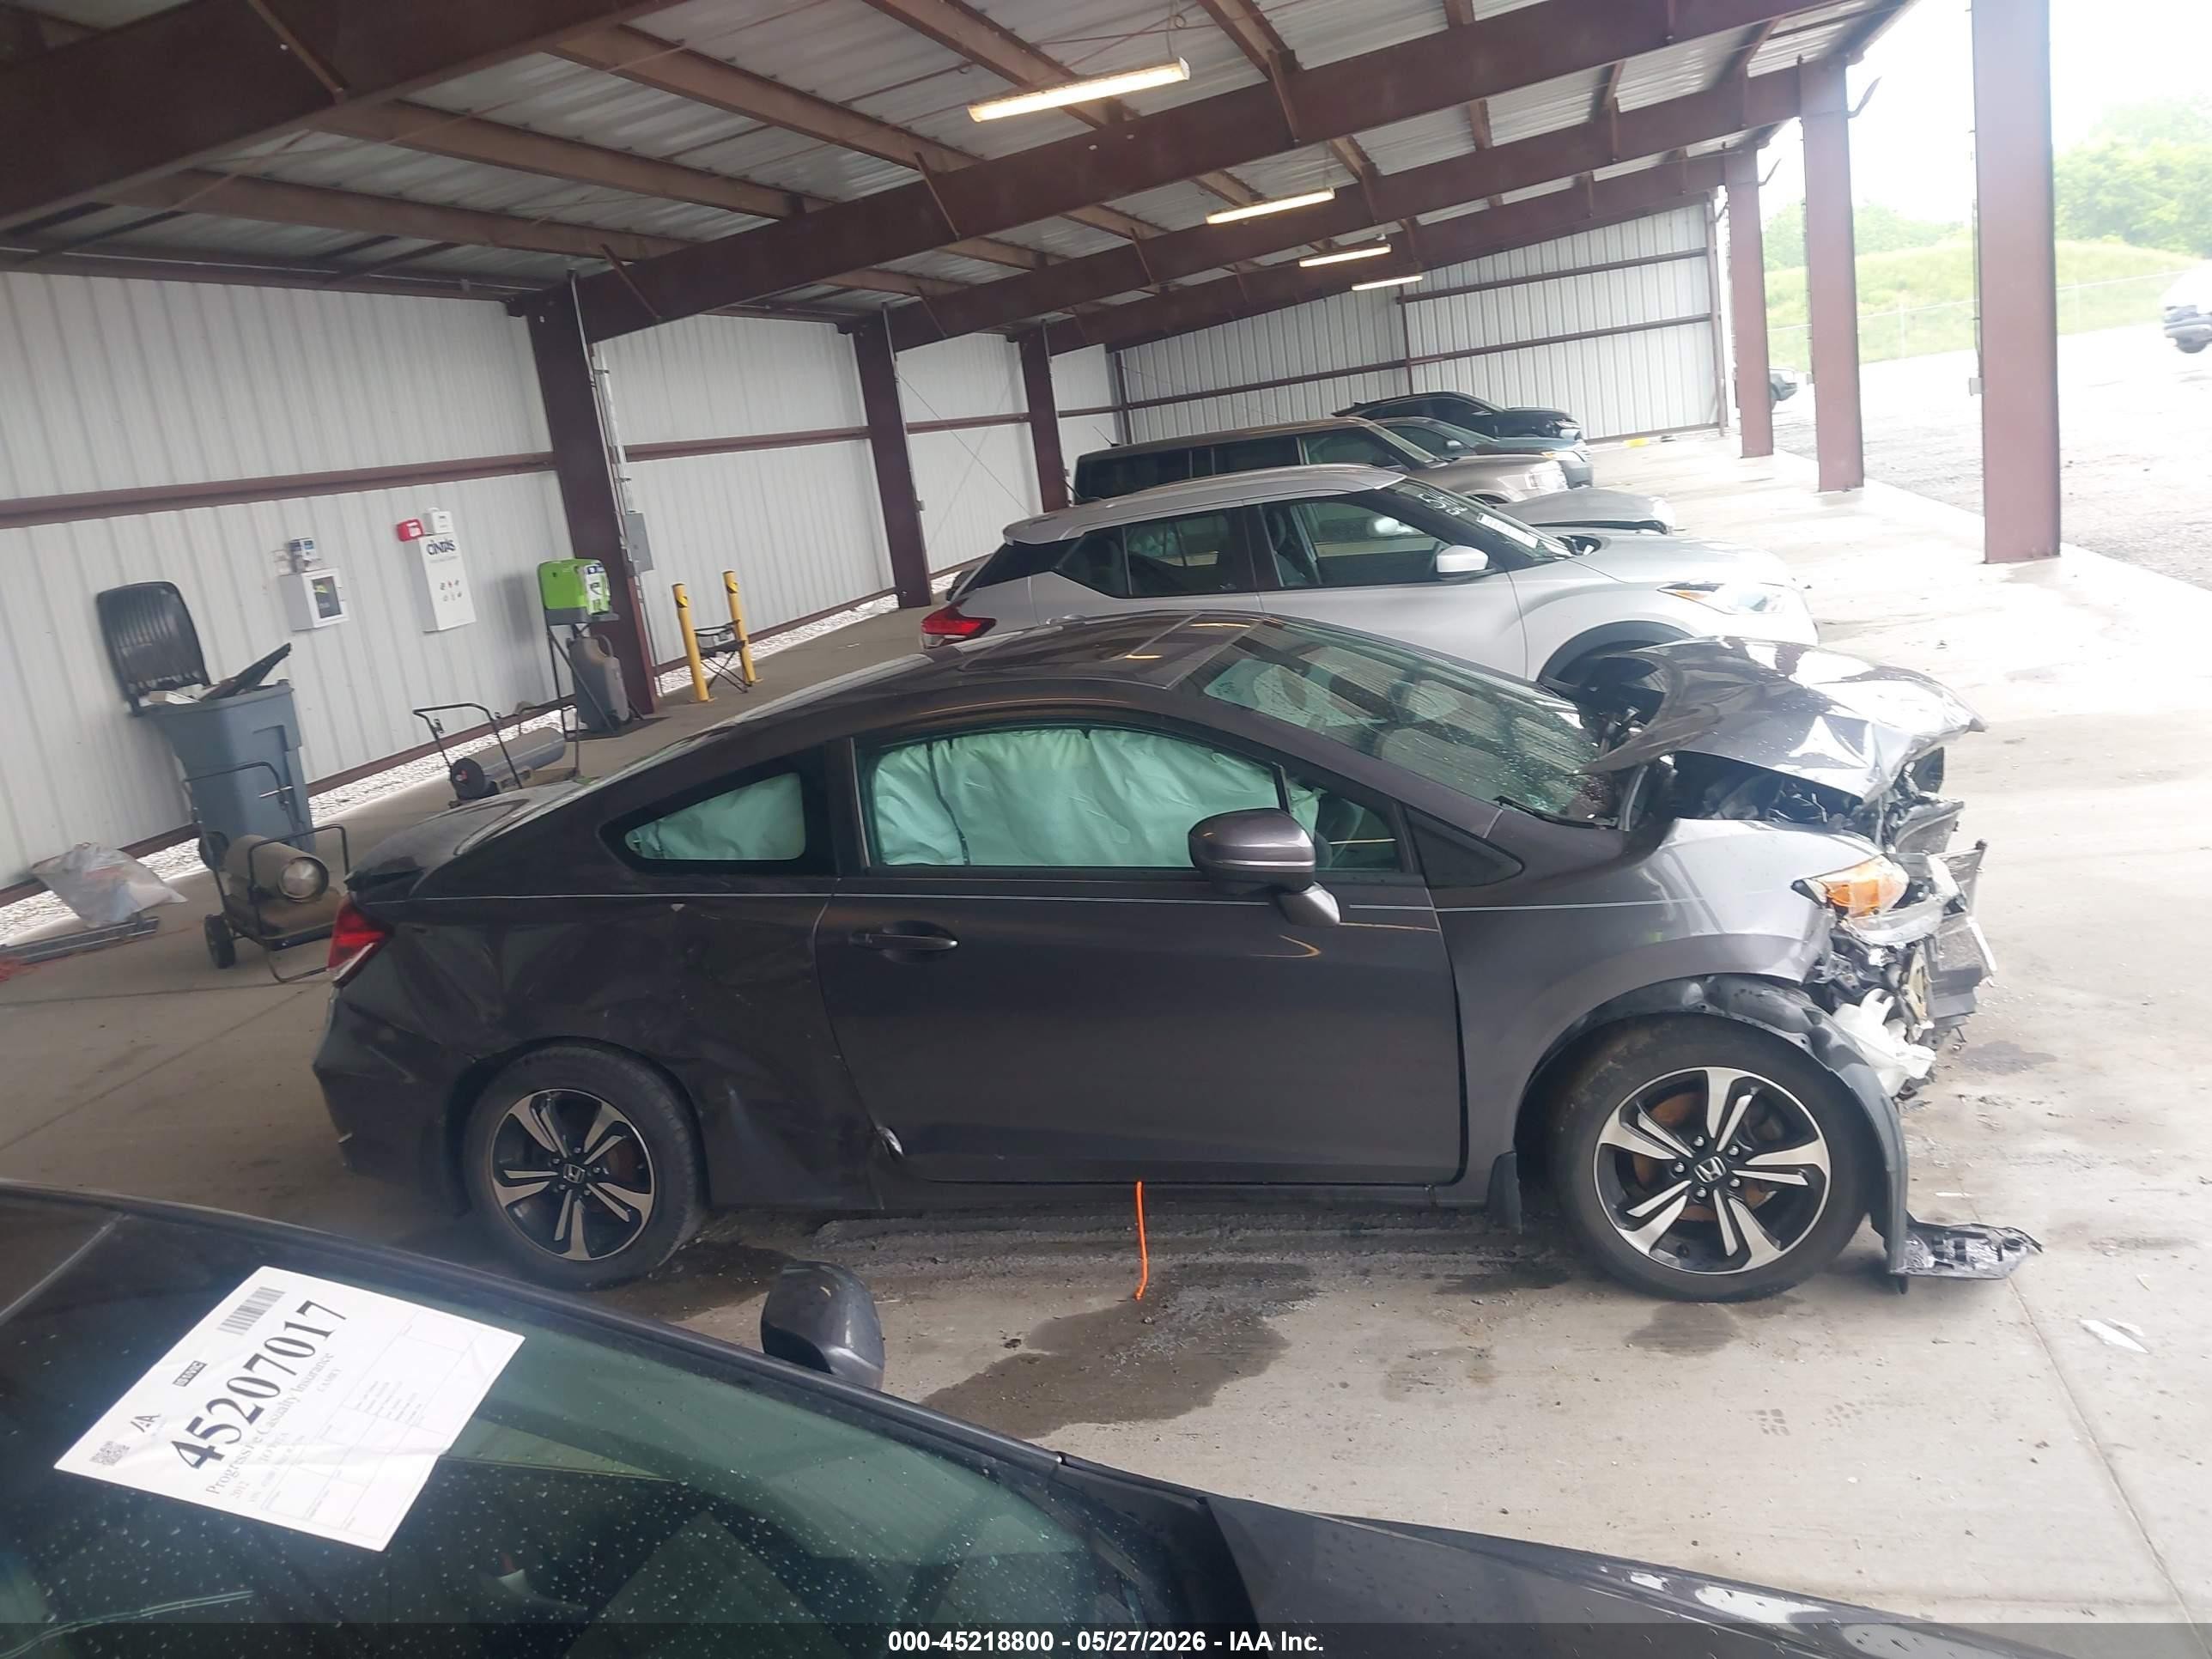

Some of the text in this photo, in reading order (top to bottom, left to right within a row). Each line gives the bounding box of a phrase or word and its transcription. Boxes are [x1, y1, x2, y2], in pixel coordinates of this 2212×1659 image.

[170, 1299, 347, 1470] 45207017
[205, 1436, 264, 1495] Progressie
[255, 1395, 301, 1436] Casualty
[290, 1352, 335, 1393] Insurance
